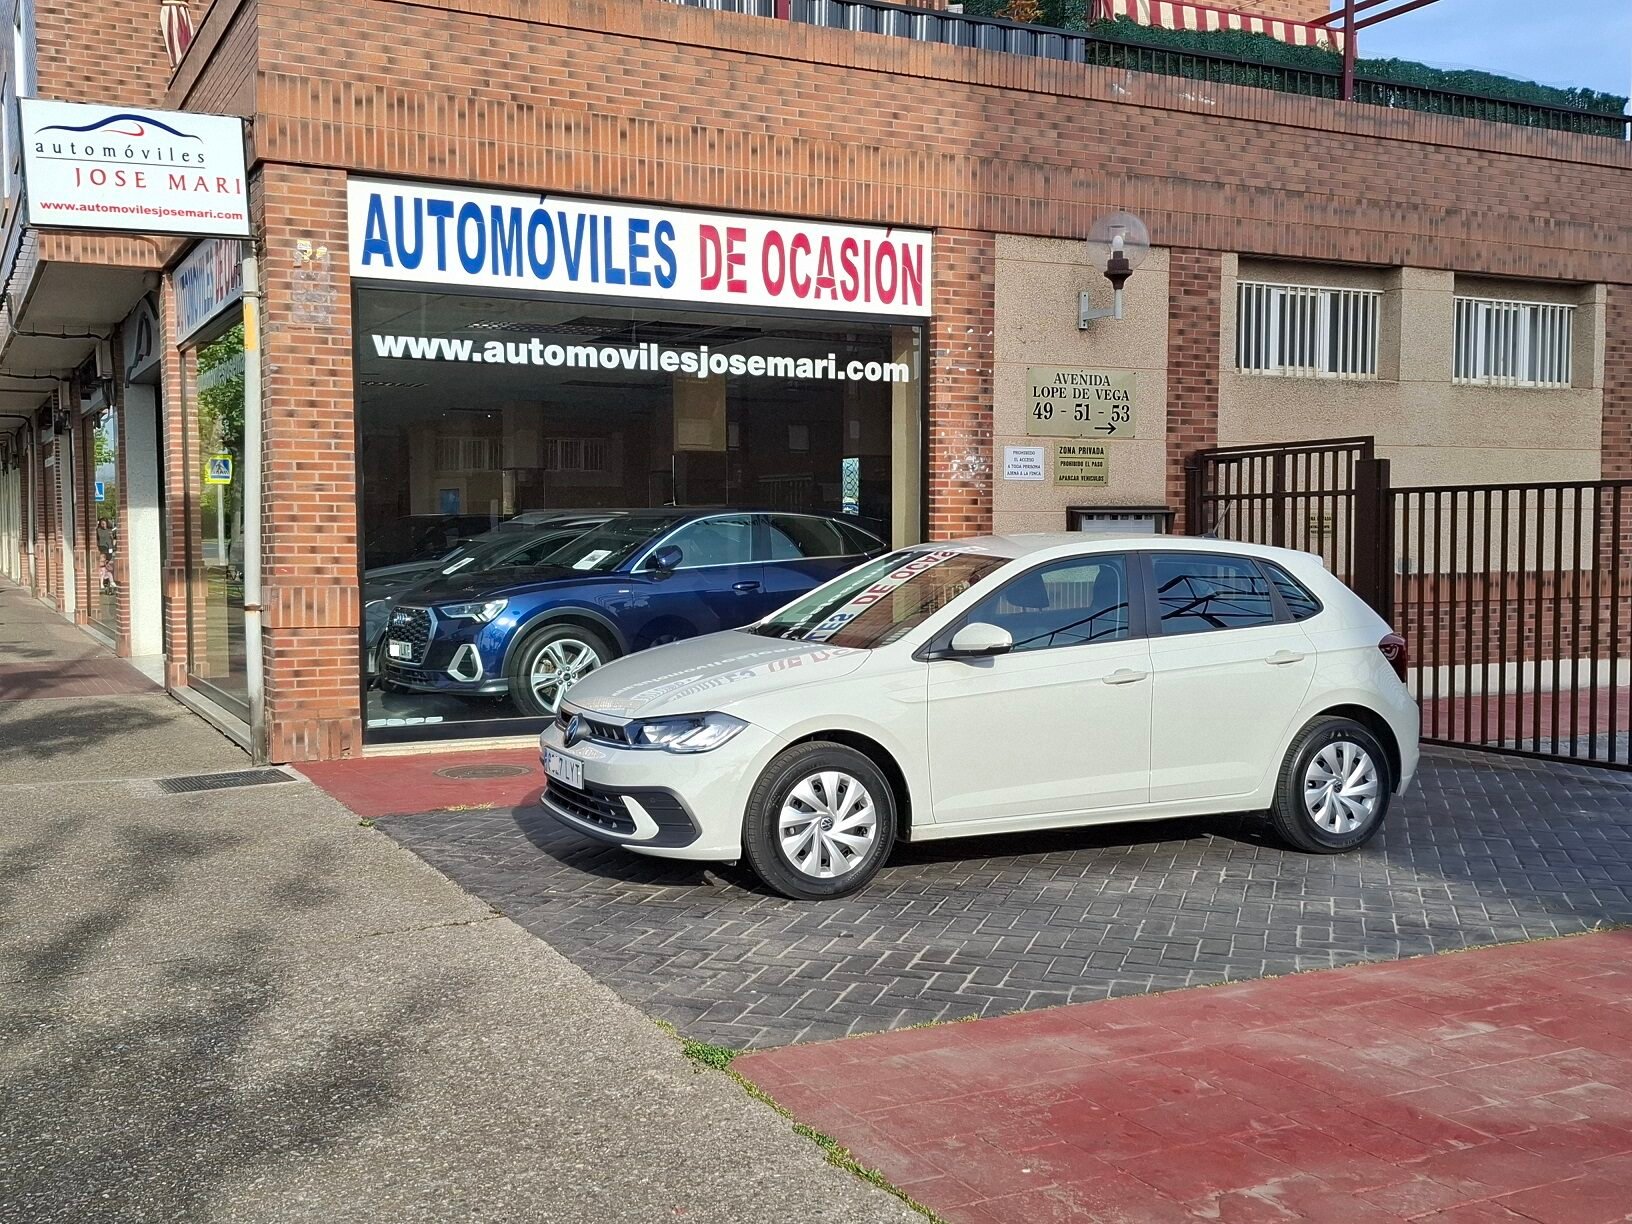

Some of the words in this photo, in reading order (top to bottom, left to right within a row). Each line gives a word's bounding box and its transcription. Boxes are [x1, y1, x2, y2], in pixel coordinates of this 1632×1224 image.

[35, 142, 204, 163] automóviles
[75, 167, 147, 188] JOSE
[168, 173, 241, 195] MARI
[40, 201, 243, 220] www.automovilesjosemari.com
[361, 193, 678, 289] AUTOMÓVILES
[699, 223, 748, 294] DE
[761, 224, 924, 307] OCASIÓN
[371, 333, 910, 383] www.automovilesjosemari.com
[1053, 372, 1111, 387] AVENIDA
[1033, 386, 1067, 398] LOPE
[1073, 387, 1090, 400] DE
[1095, 388, 1130, 401] VEGA
[1032, 401, 1053, 420] 49
[1074, 403, 1091, 421] 51
[1111, 404, 1130, 422] 53
[1059, 446, 1076, 455] ZONA
[1078, 446, 1105, 455] PRIVADA
